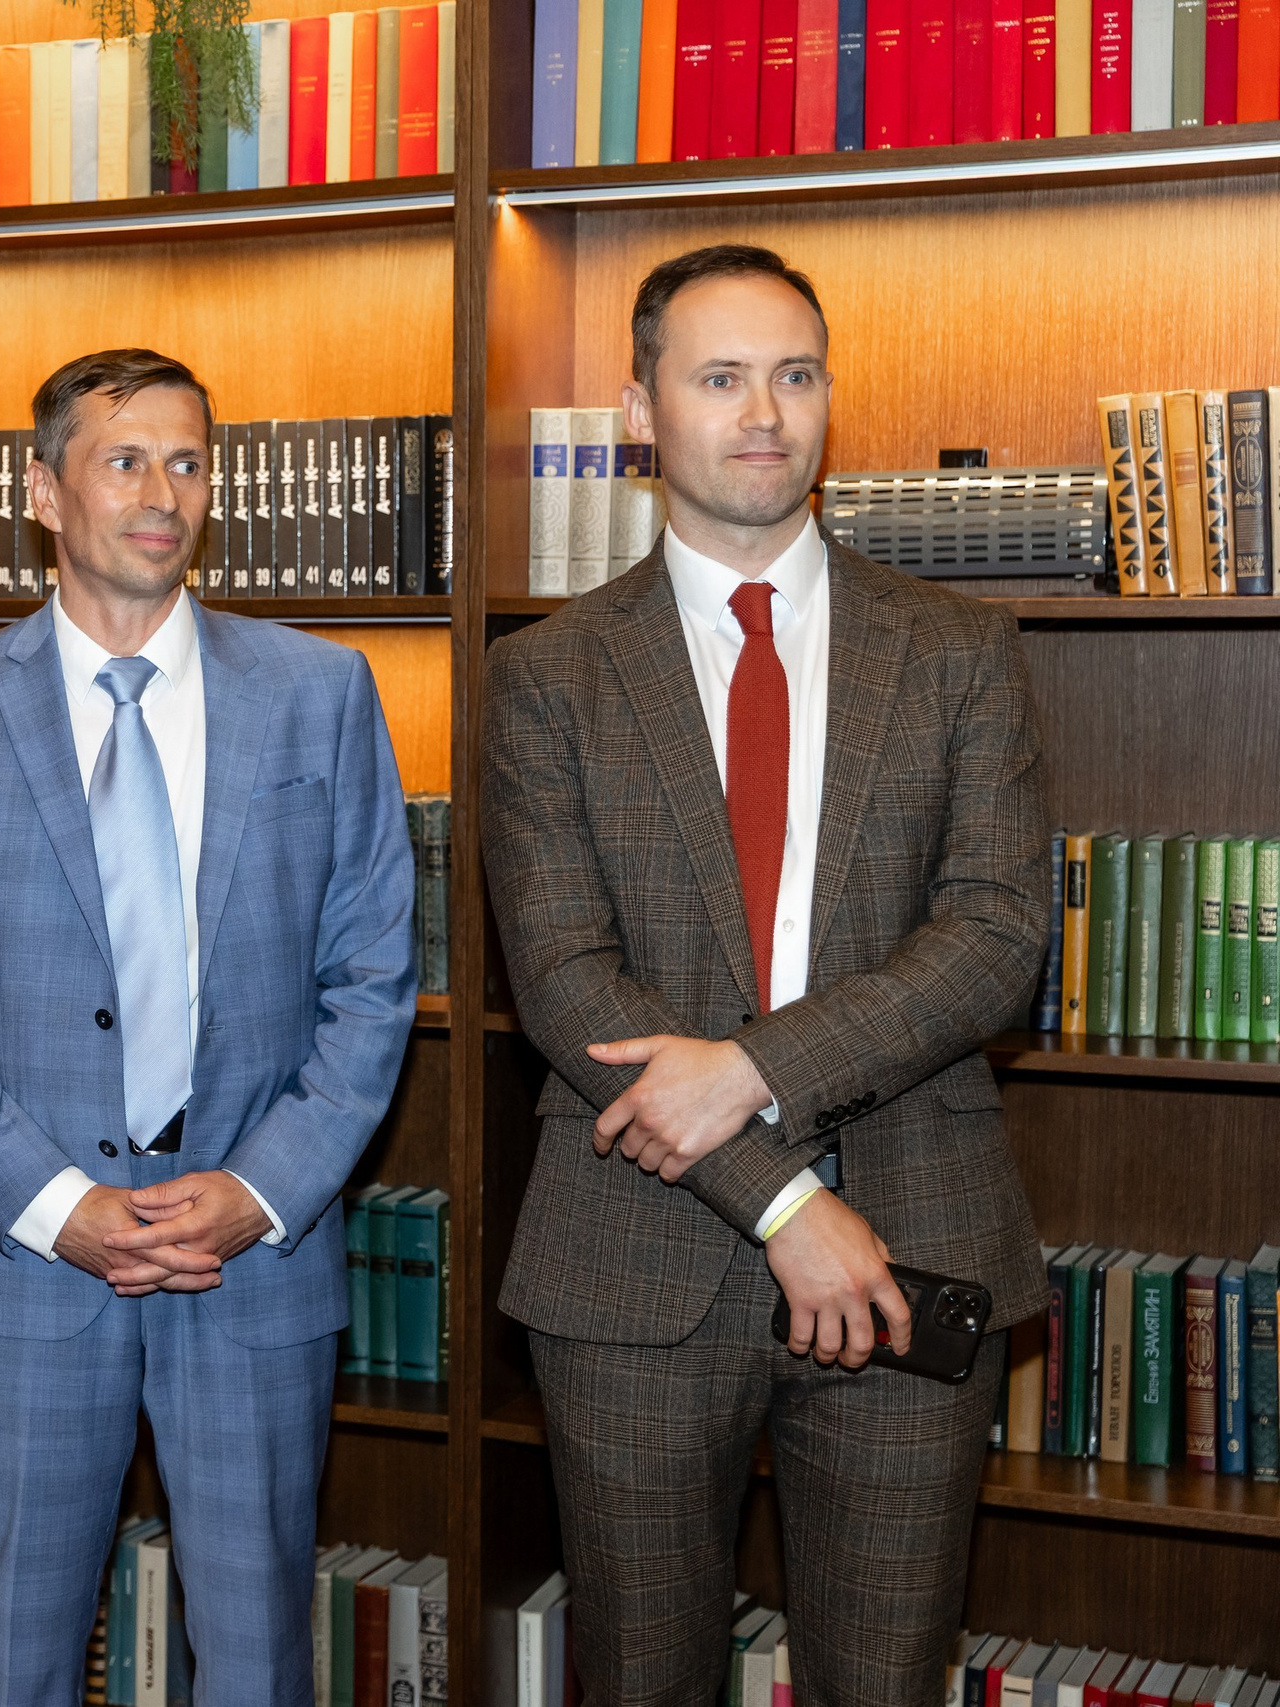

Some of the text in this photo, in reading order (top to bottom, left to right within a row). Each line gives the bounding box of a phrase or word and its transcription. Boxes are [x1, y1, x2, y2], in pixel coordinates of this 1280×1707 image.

[208, 568, 223, 588] 37
[234, 569, 248, 588] 38
[255, 567, 270, 587] 39
[280, 567, 296, 587] 40
[305, 565, 319, 584] 41
[328, 568, 344, 587] 42
[350, 566, 367, 585] 44
[374, 565, 390, 585] 45
[1144, 1288, 1160, 1358] ЗАМЯТИН
